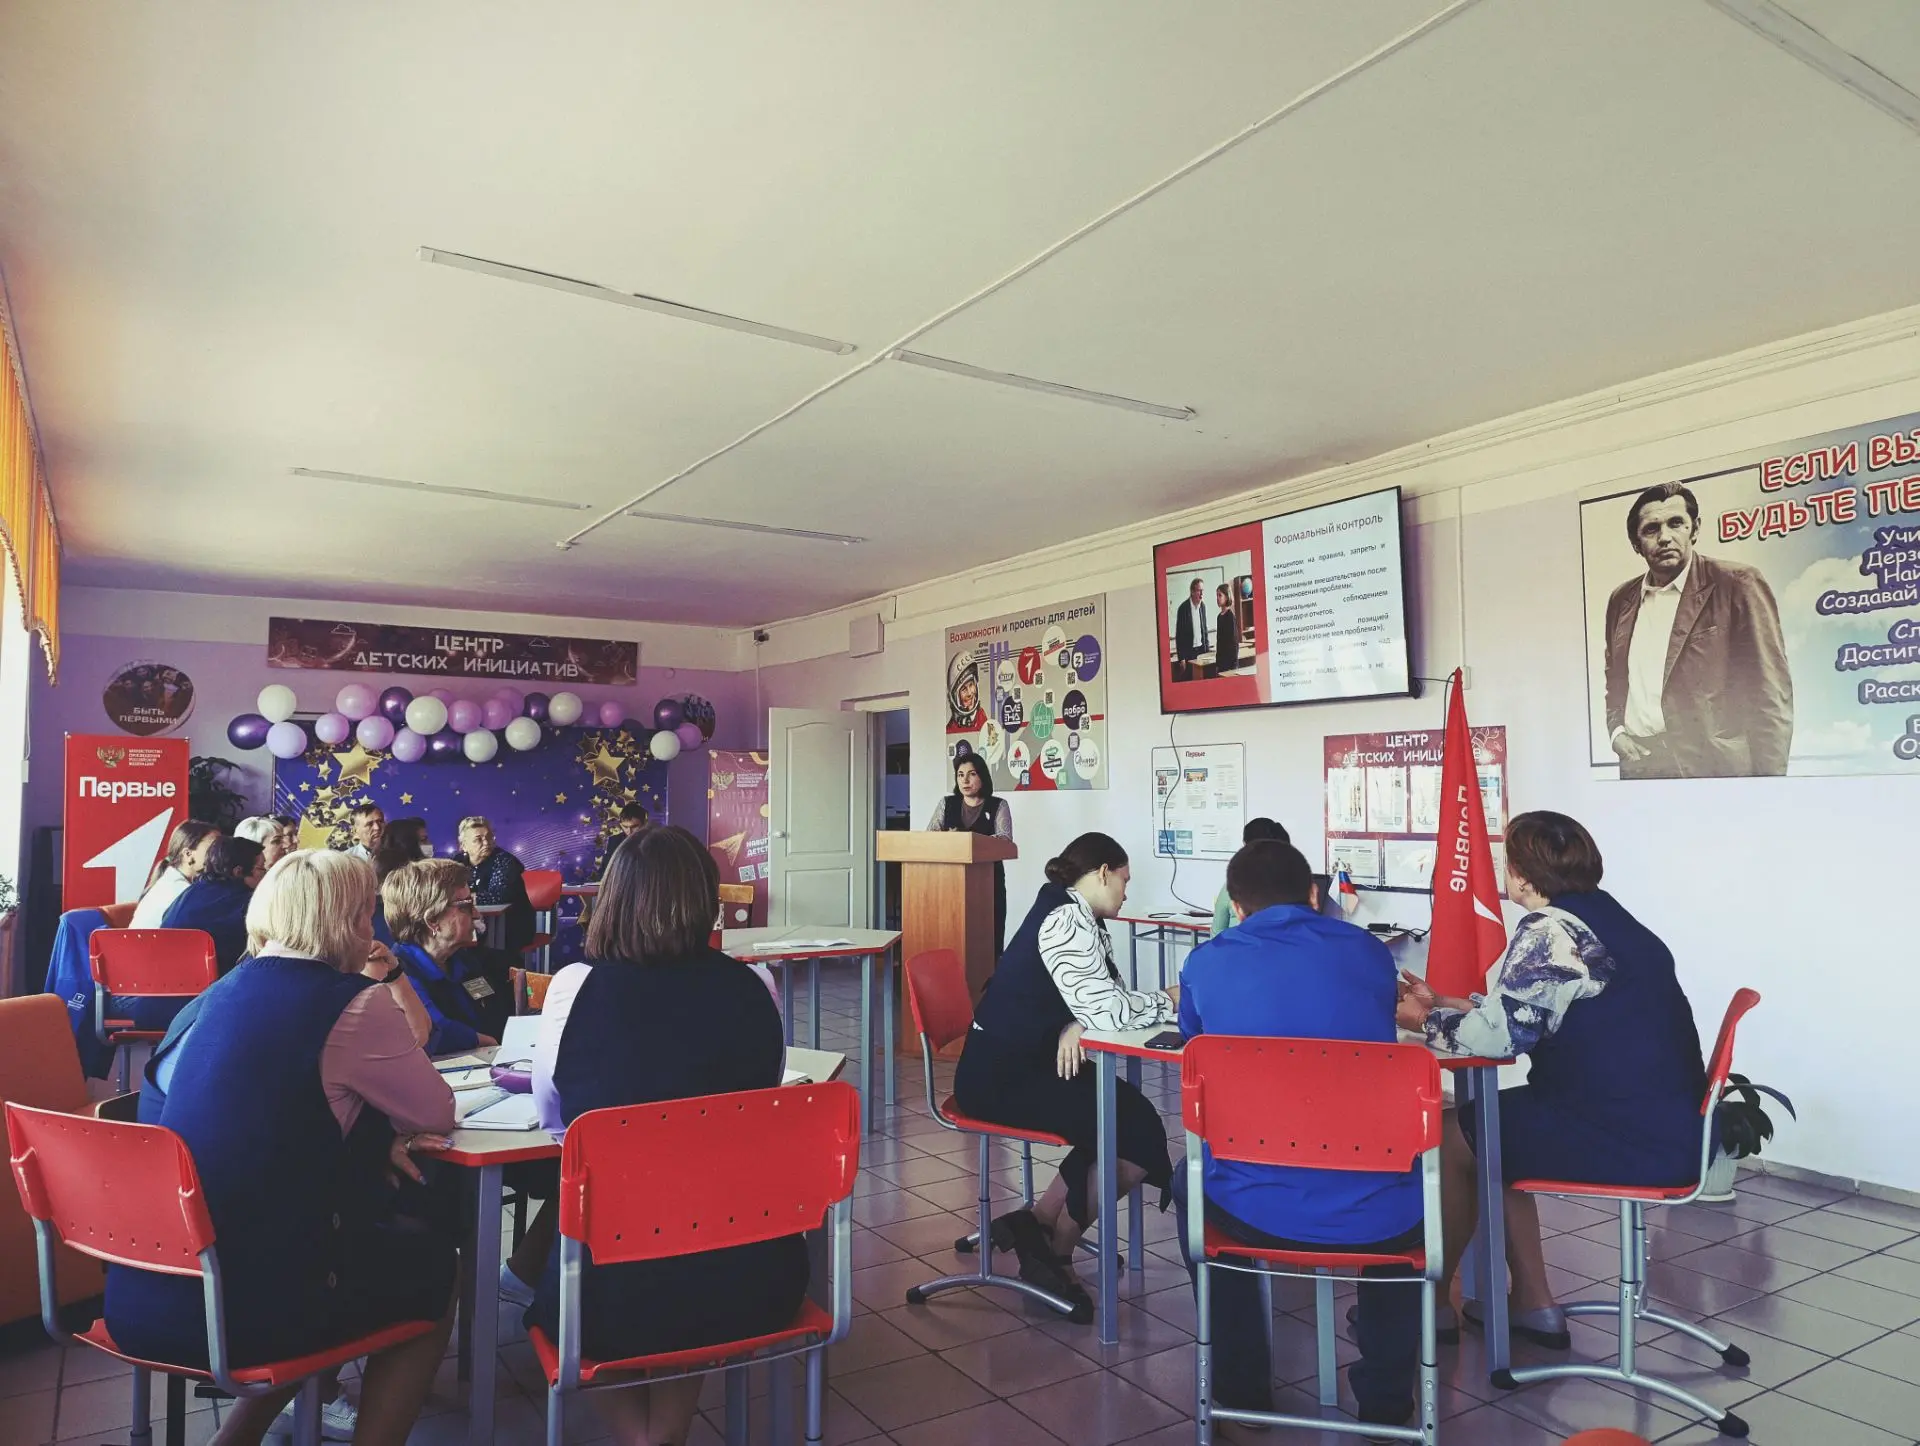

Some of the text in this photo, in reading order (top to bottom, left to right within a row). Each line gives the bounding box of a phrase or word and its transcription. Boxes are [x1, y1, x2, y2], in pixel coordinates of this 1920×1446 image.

[1761, 441, 1858, 491] ЕСЛИ
[1719, 477, 1920, 542] БУДЬТЕ ПЕ
[1274, 514, 1383, 545] Формальный контроль
[1350, 544, 1377, 555] запреты
[1367, 566, 1387, 575] после
[1343, 591, 1388, 603] соблюдением
[1822, 584, 1918, 610] Создавай
[950, 602, 1096, 644] Возможности и проекты для детей
[1357, 612, 1389, 624] позицией
[435, 635, 504, 653] ЦЕНТР
[353, 651, 579, 677] ДЕТСКИХ ИНИЦИАТИВ
[133, 707, 164, 716] БЫТЬ
[119, 715, 178, 724] ПЕРВЫМИ
[1385, 734, 1429, 748] ЦЕНТР
[1185, 751, 1206, 759] Первые
[1342, 752, 1394, 764] ДЕТСКИХ
[1010, 759, 1028, 768] АРТЕК
[80, 776, 176, 804] Первые
